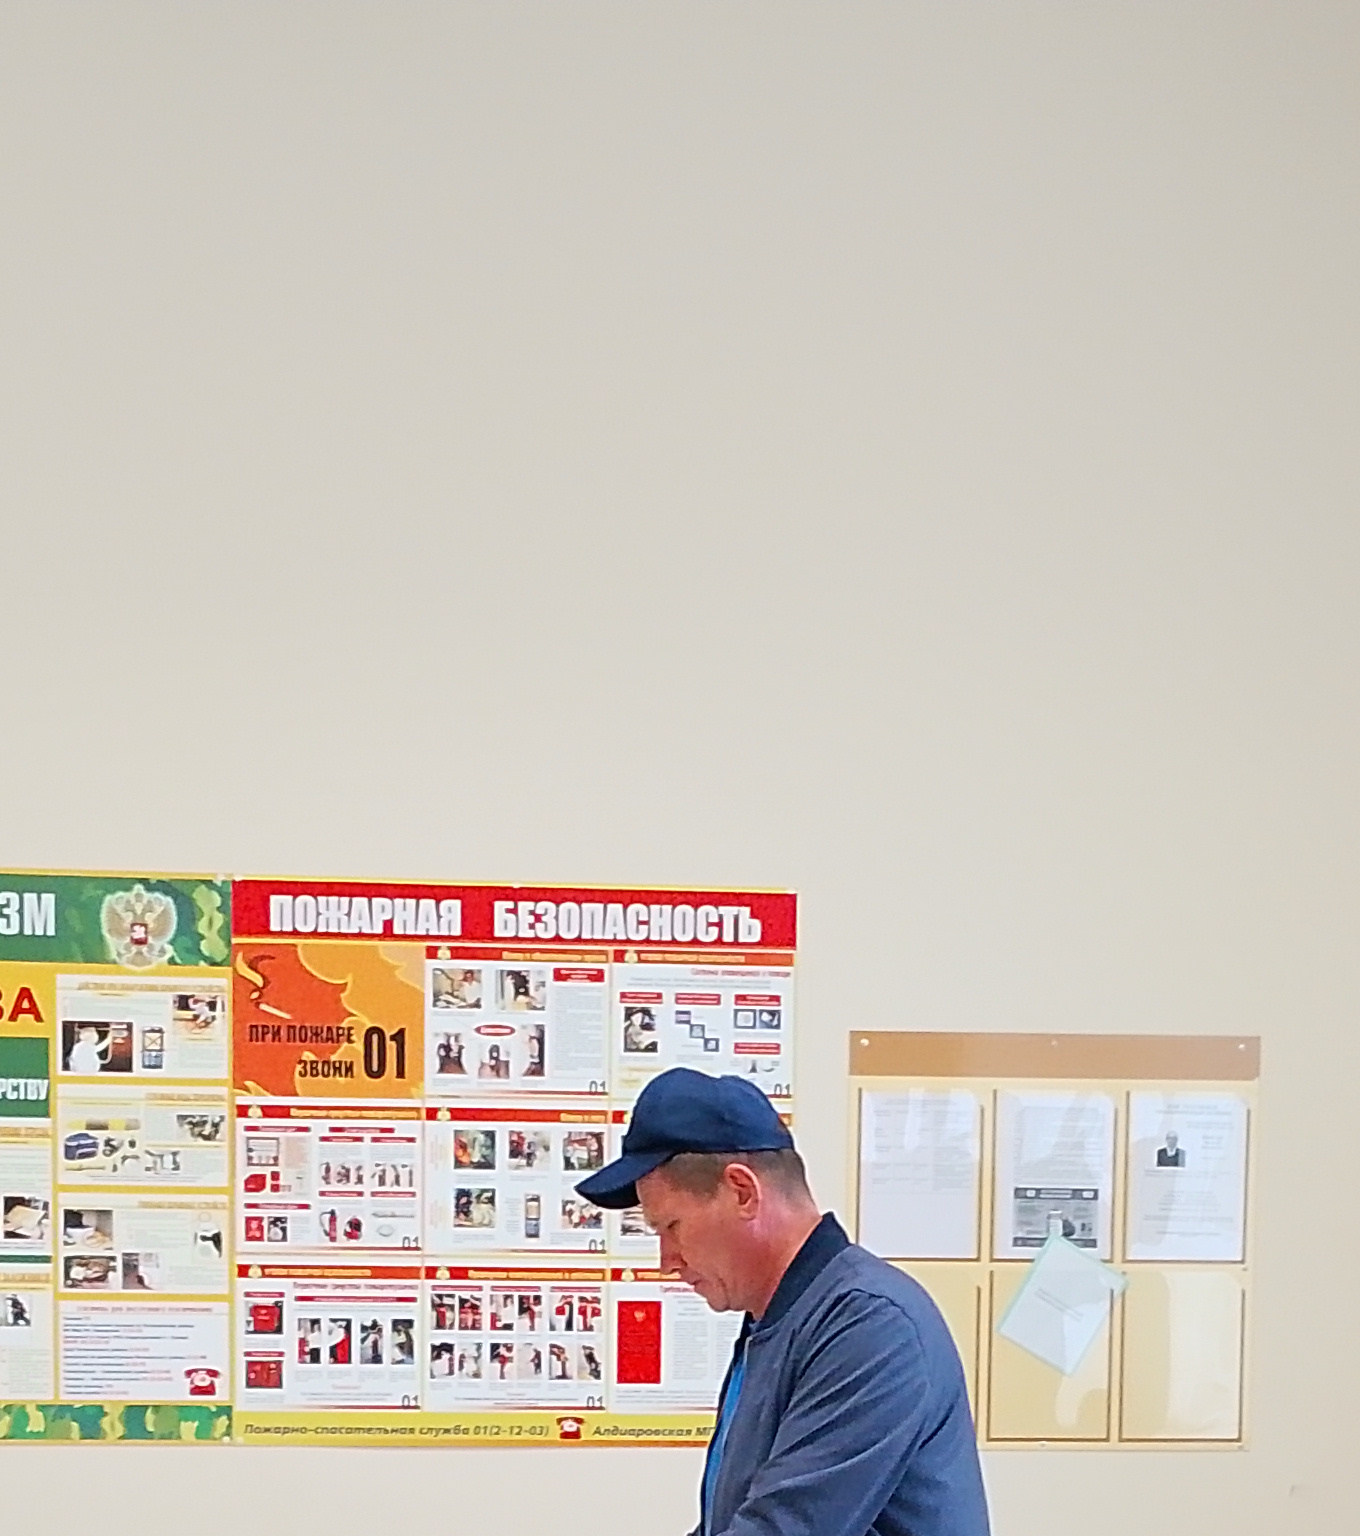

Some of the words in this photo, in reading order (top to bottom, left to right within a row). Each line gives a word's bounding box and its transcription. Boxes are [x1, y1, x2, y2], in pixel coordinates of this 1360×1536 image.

[269, 894, 462, 936] ПОЖАРНАЯ
[493, 899, 762, 943] БЕЗОПАСНОСТЬ
[249, 1024, 281, 1043] ПРИ
[286, 1025, 356, 1044] ПОЖАРЕ
[363, 1026, 406, 1080] 01
[297, 1059, 354, 1079] ЗВОНИ
[589, 1080, 607, 1096] 01
[402, 1236, 420, 1250] 01
[588, 1239, 607, 1254] 01
[401, 1394, 420, 1409] 01
[586, 1395, 605, 1410] 01
